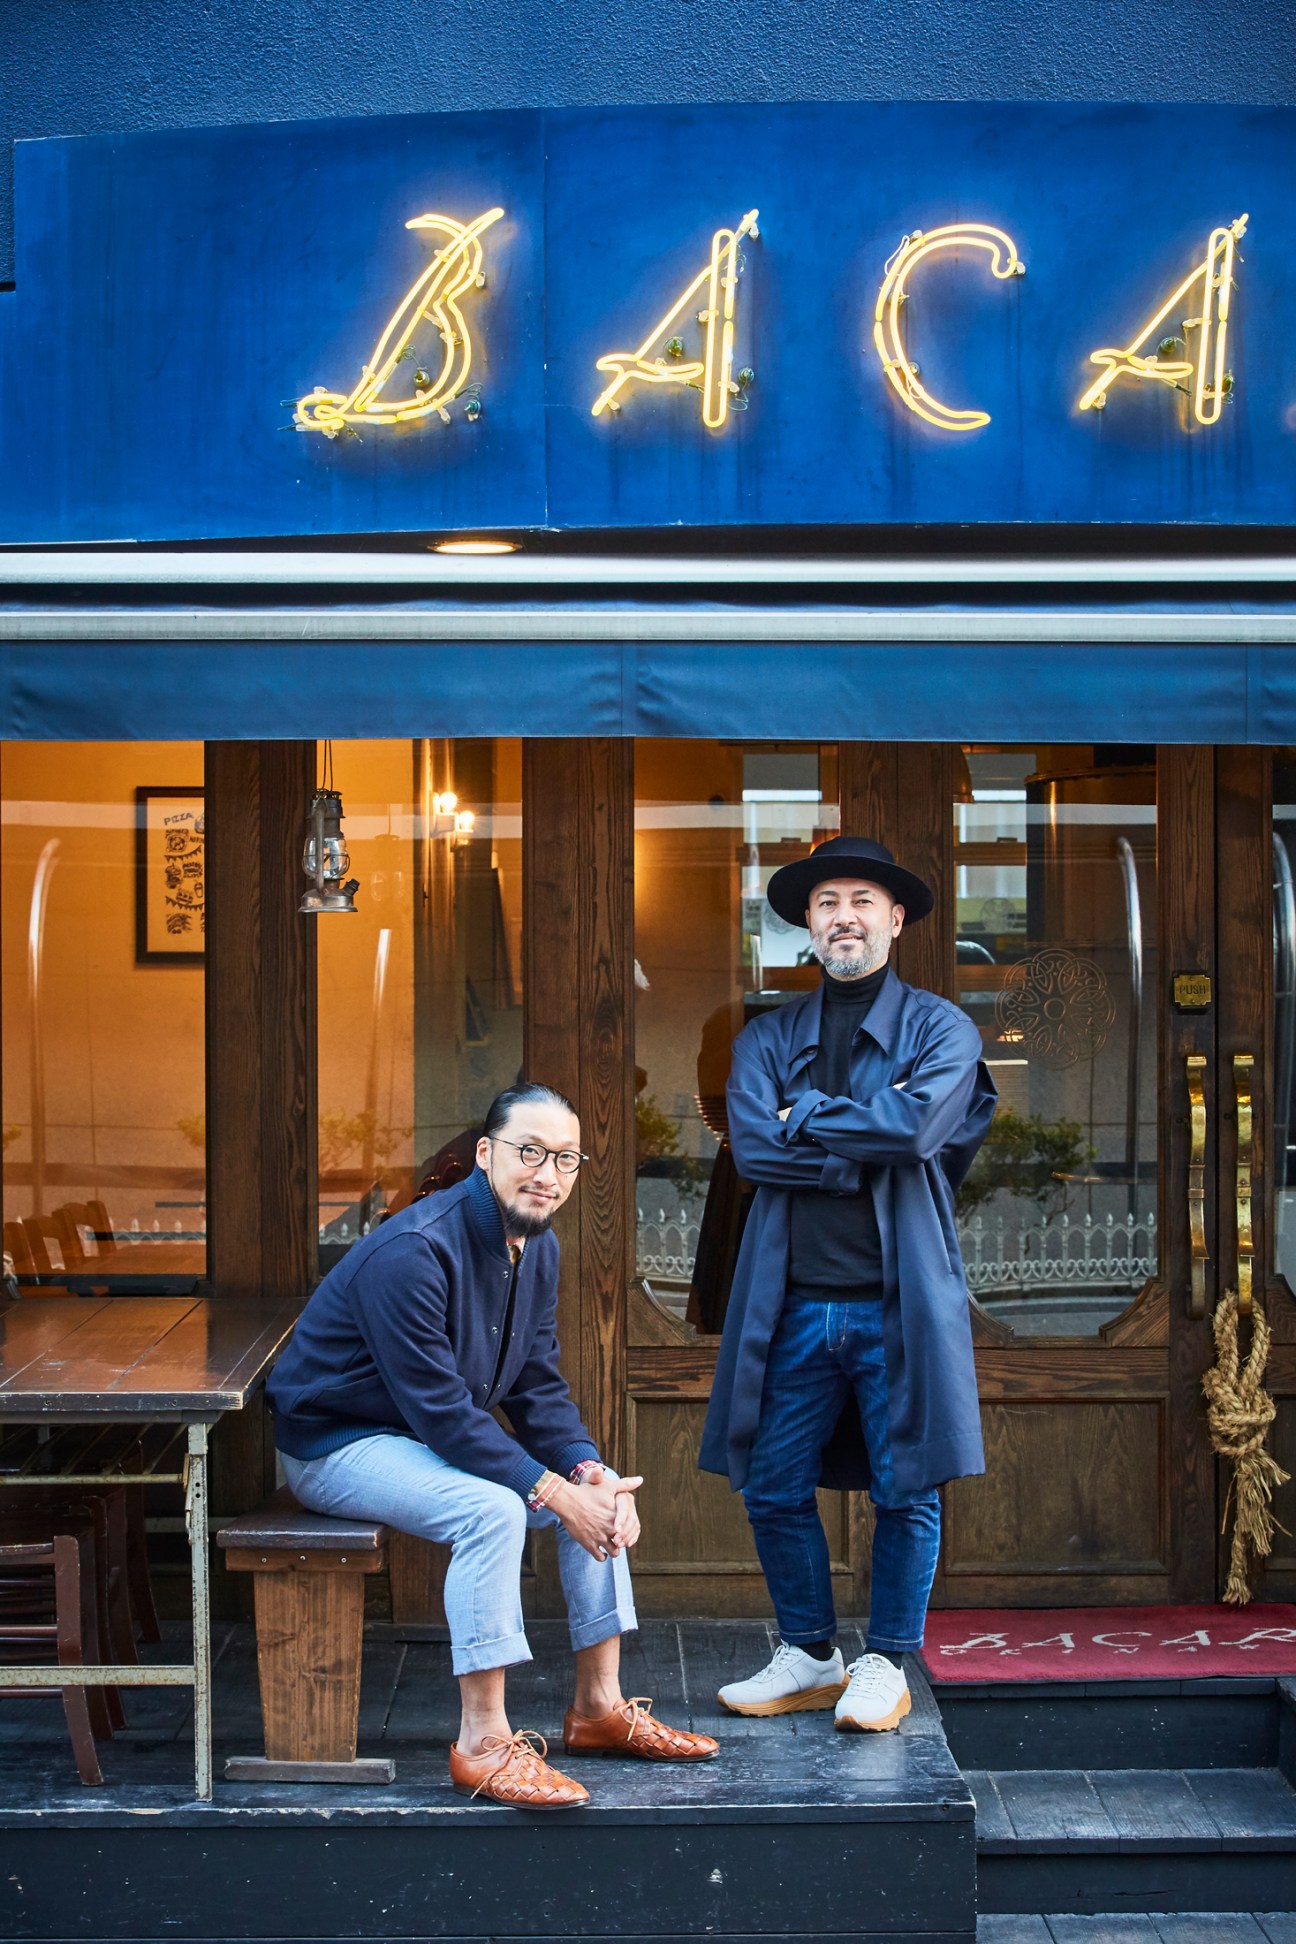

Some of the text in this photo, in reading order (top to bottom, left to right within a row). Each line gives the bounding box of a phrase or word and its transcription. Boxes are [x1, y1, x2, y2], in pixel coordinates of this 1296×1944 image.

[164, 812, 194, 826] PIZZA
[1179, 984, 1206, 995] PUSH
[939, 1627, 1296, 1649] BACAR
